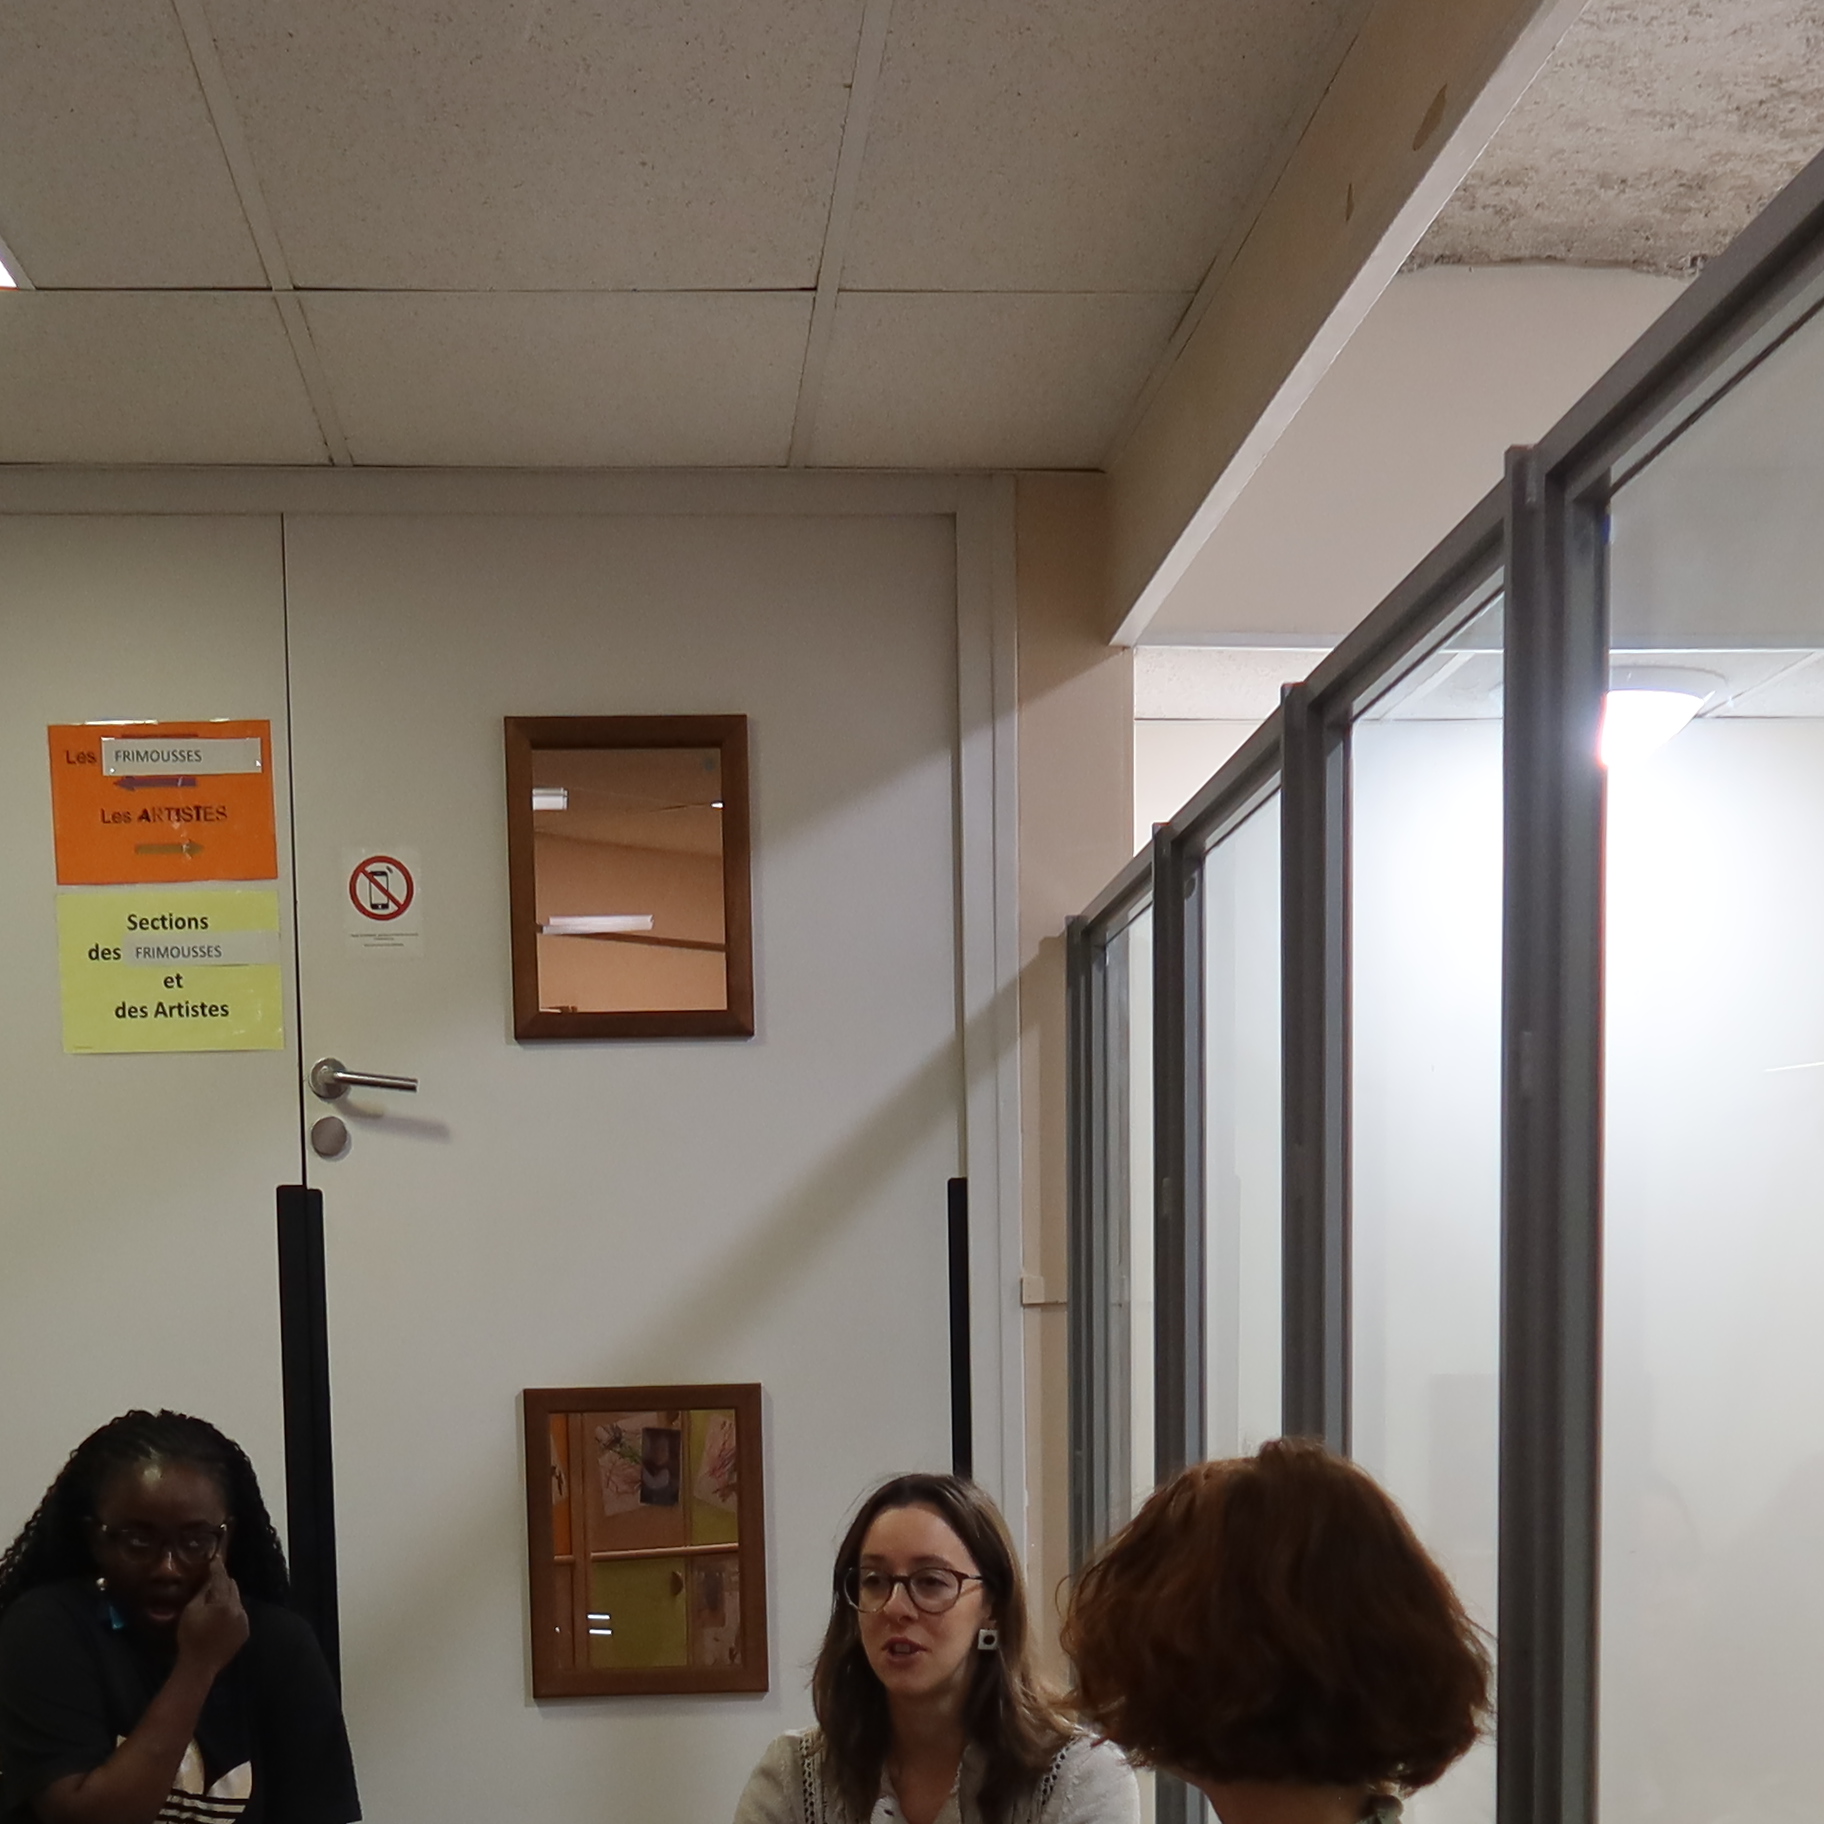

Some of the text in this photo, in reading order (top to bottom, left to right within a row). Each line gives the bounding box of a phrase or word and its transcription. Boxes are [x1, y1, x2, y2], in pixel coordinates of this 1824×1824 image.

[66, 749, 203, 764] Les FRIMOUSSES
[101, 805, 228, 824] Les ARTISTES
[127, 913, 209, 931] Sections
[88, 943, 222, 960] des FRIMOUSSES
[163, 973, 184, 989] et
[115, 1000, 229, 1019] des Artistes
